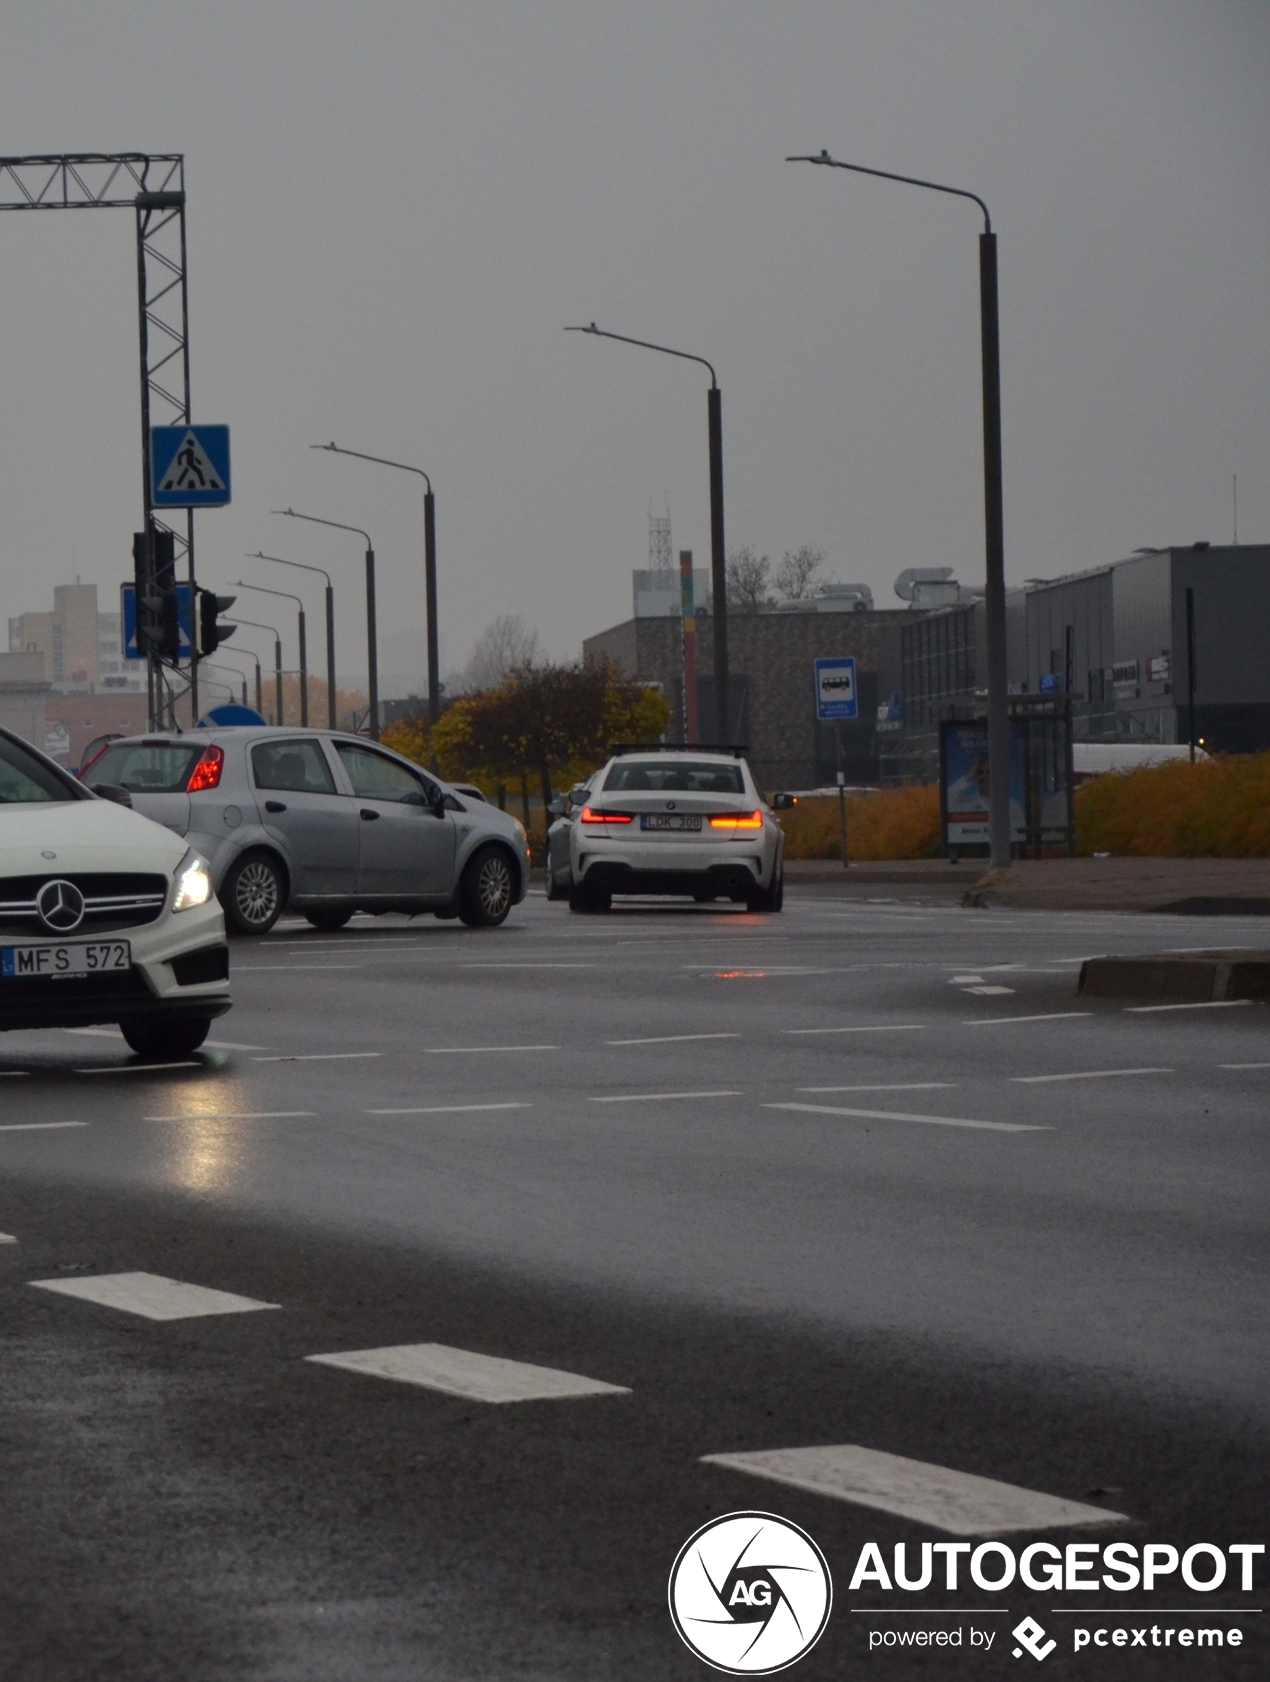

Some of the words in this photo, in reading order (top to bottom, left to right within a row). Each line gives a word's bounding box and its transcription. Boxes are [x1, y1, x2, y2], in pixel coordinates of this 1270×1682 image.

[648, 817, 671, 827] LDK
[680, 818, 700, 827] 300
[18, 948, 70, 972] MFS
[86, 945, 126, 968] 572
